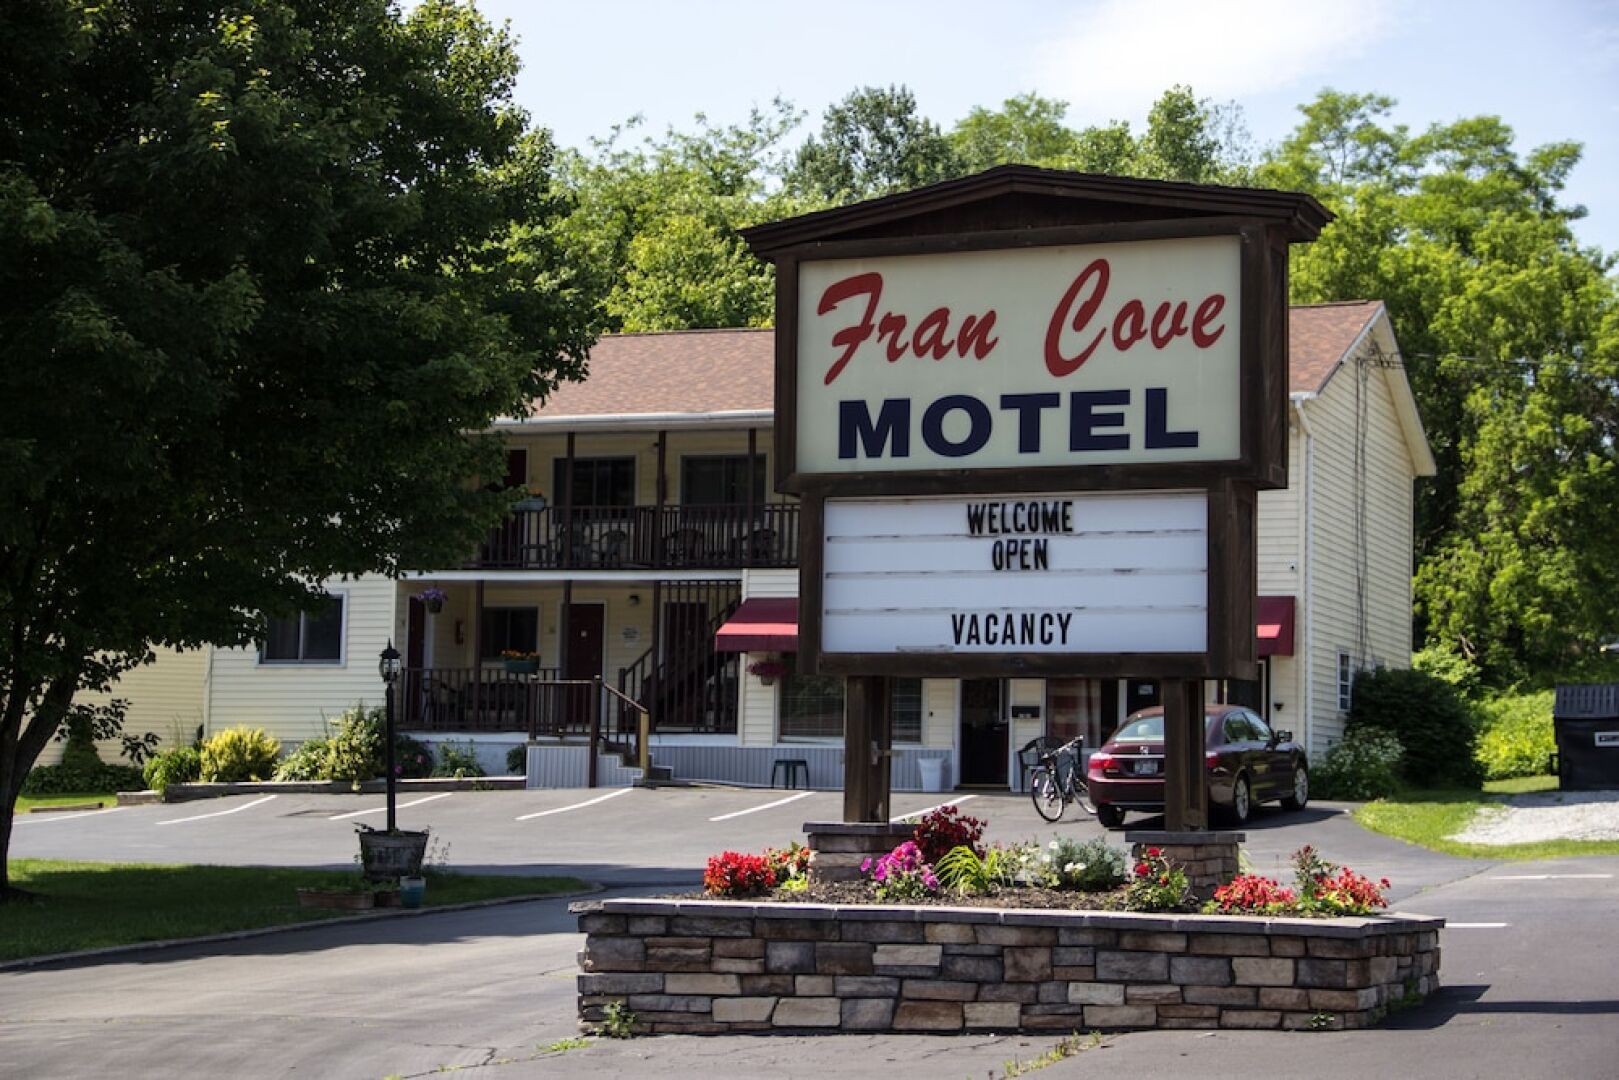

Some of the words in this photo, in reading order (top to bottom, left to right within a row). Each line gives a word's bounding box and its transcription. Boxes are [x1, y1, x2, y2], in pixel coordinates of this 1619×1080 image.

[817, 271, 999, 385] Fran
[1043, 258, 1226, 377] Cove
[838, 388, 1199, 459] MOTEL
[968, 501, 1074, 535] WELCOME
[992, 539, 1049, 571] OPEN
[952, 613, 1073, 646] VACANCY
